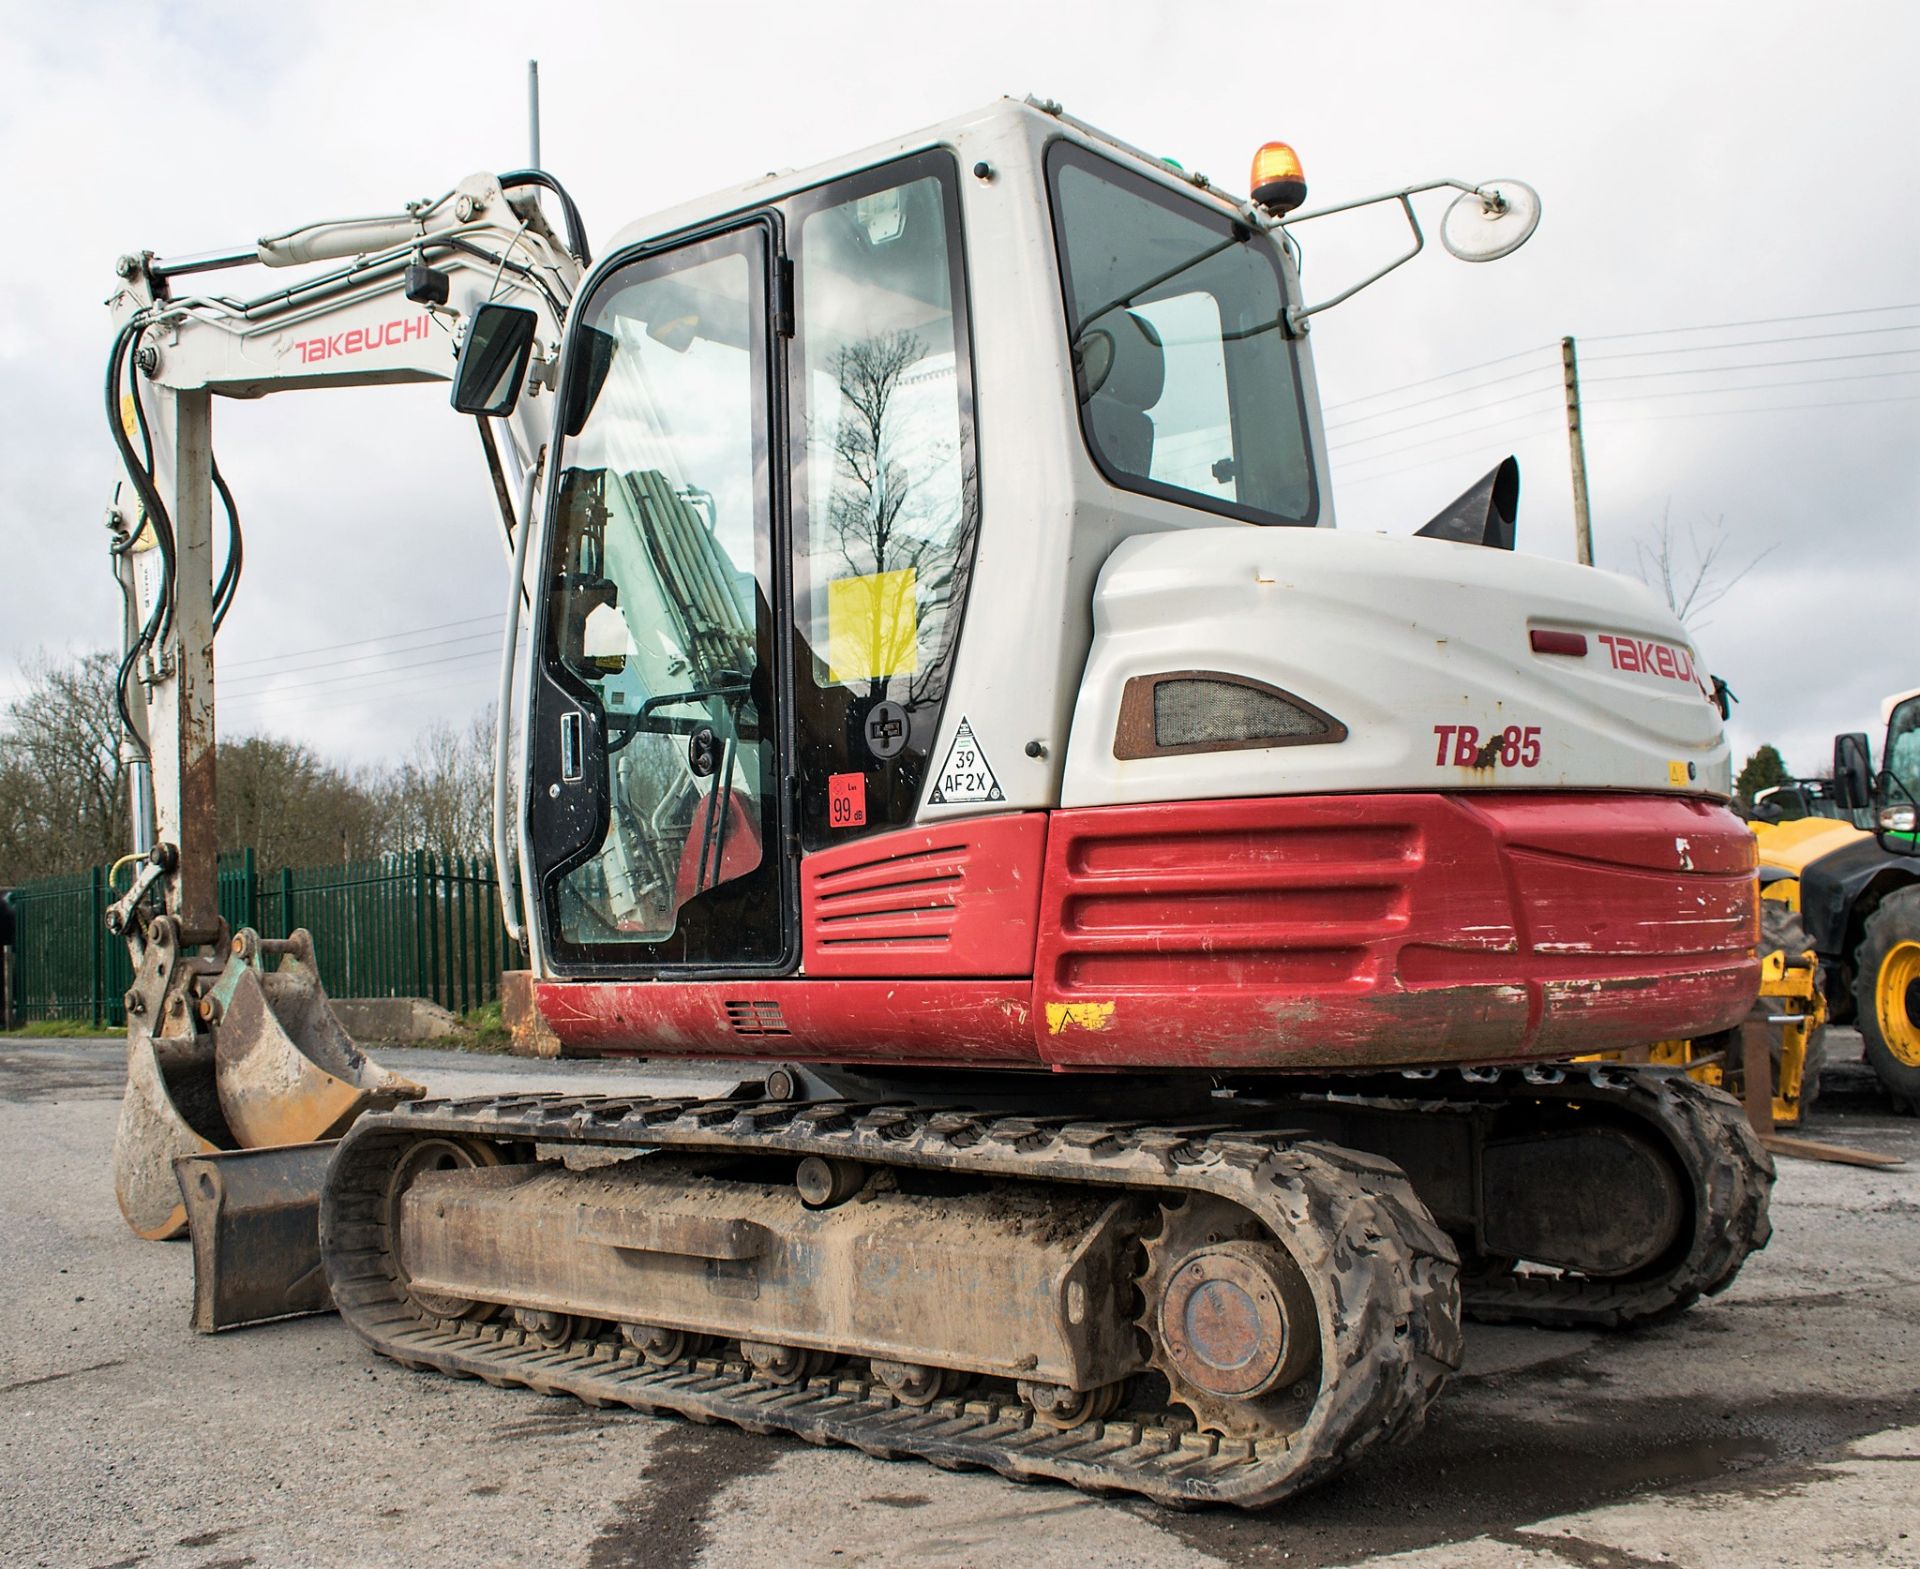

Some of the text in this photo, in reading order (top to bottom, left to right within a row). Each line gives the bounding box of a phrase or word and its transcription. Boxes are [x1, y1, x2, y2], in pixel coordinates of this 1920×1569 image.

[295, 315, 430, 364] TAKEUCHI
[1433, 725, 1542, 768] TB85
[955, 750, 975, 769] 39
[945, 772, 986, 792] AF2X
[833, 797, 851, 822] 99
